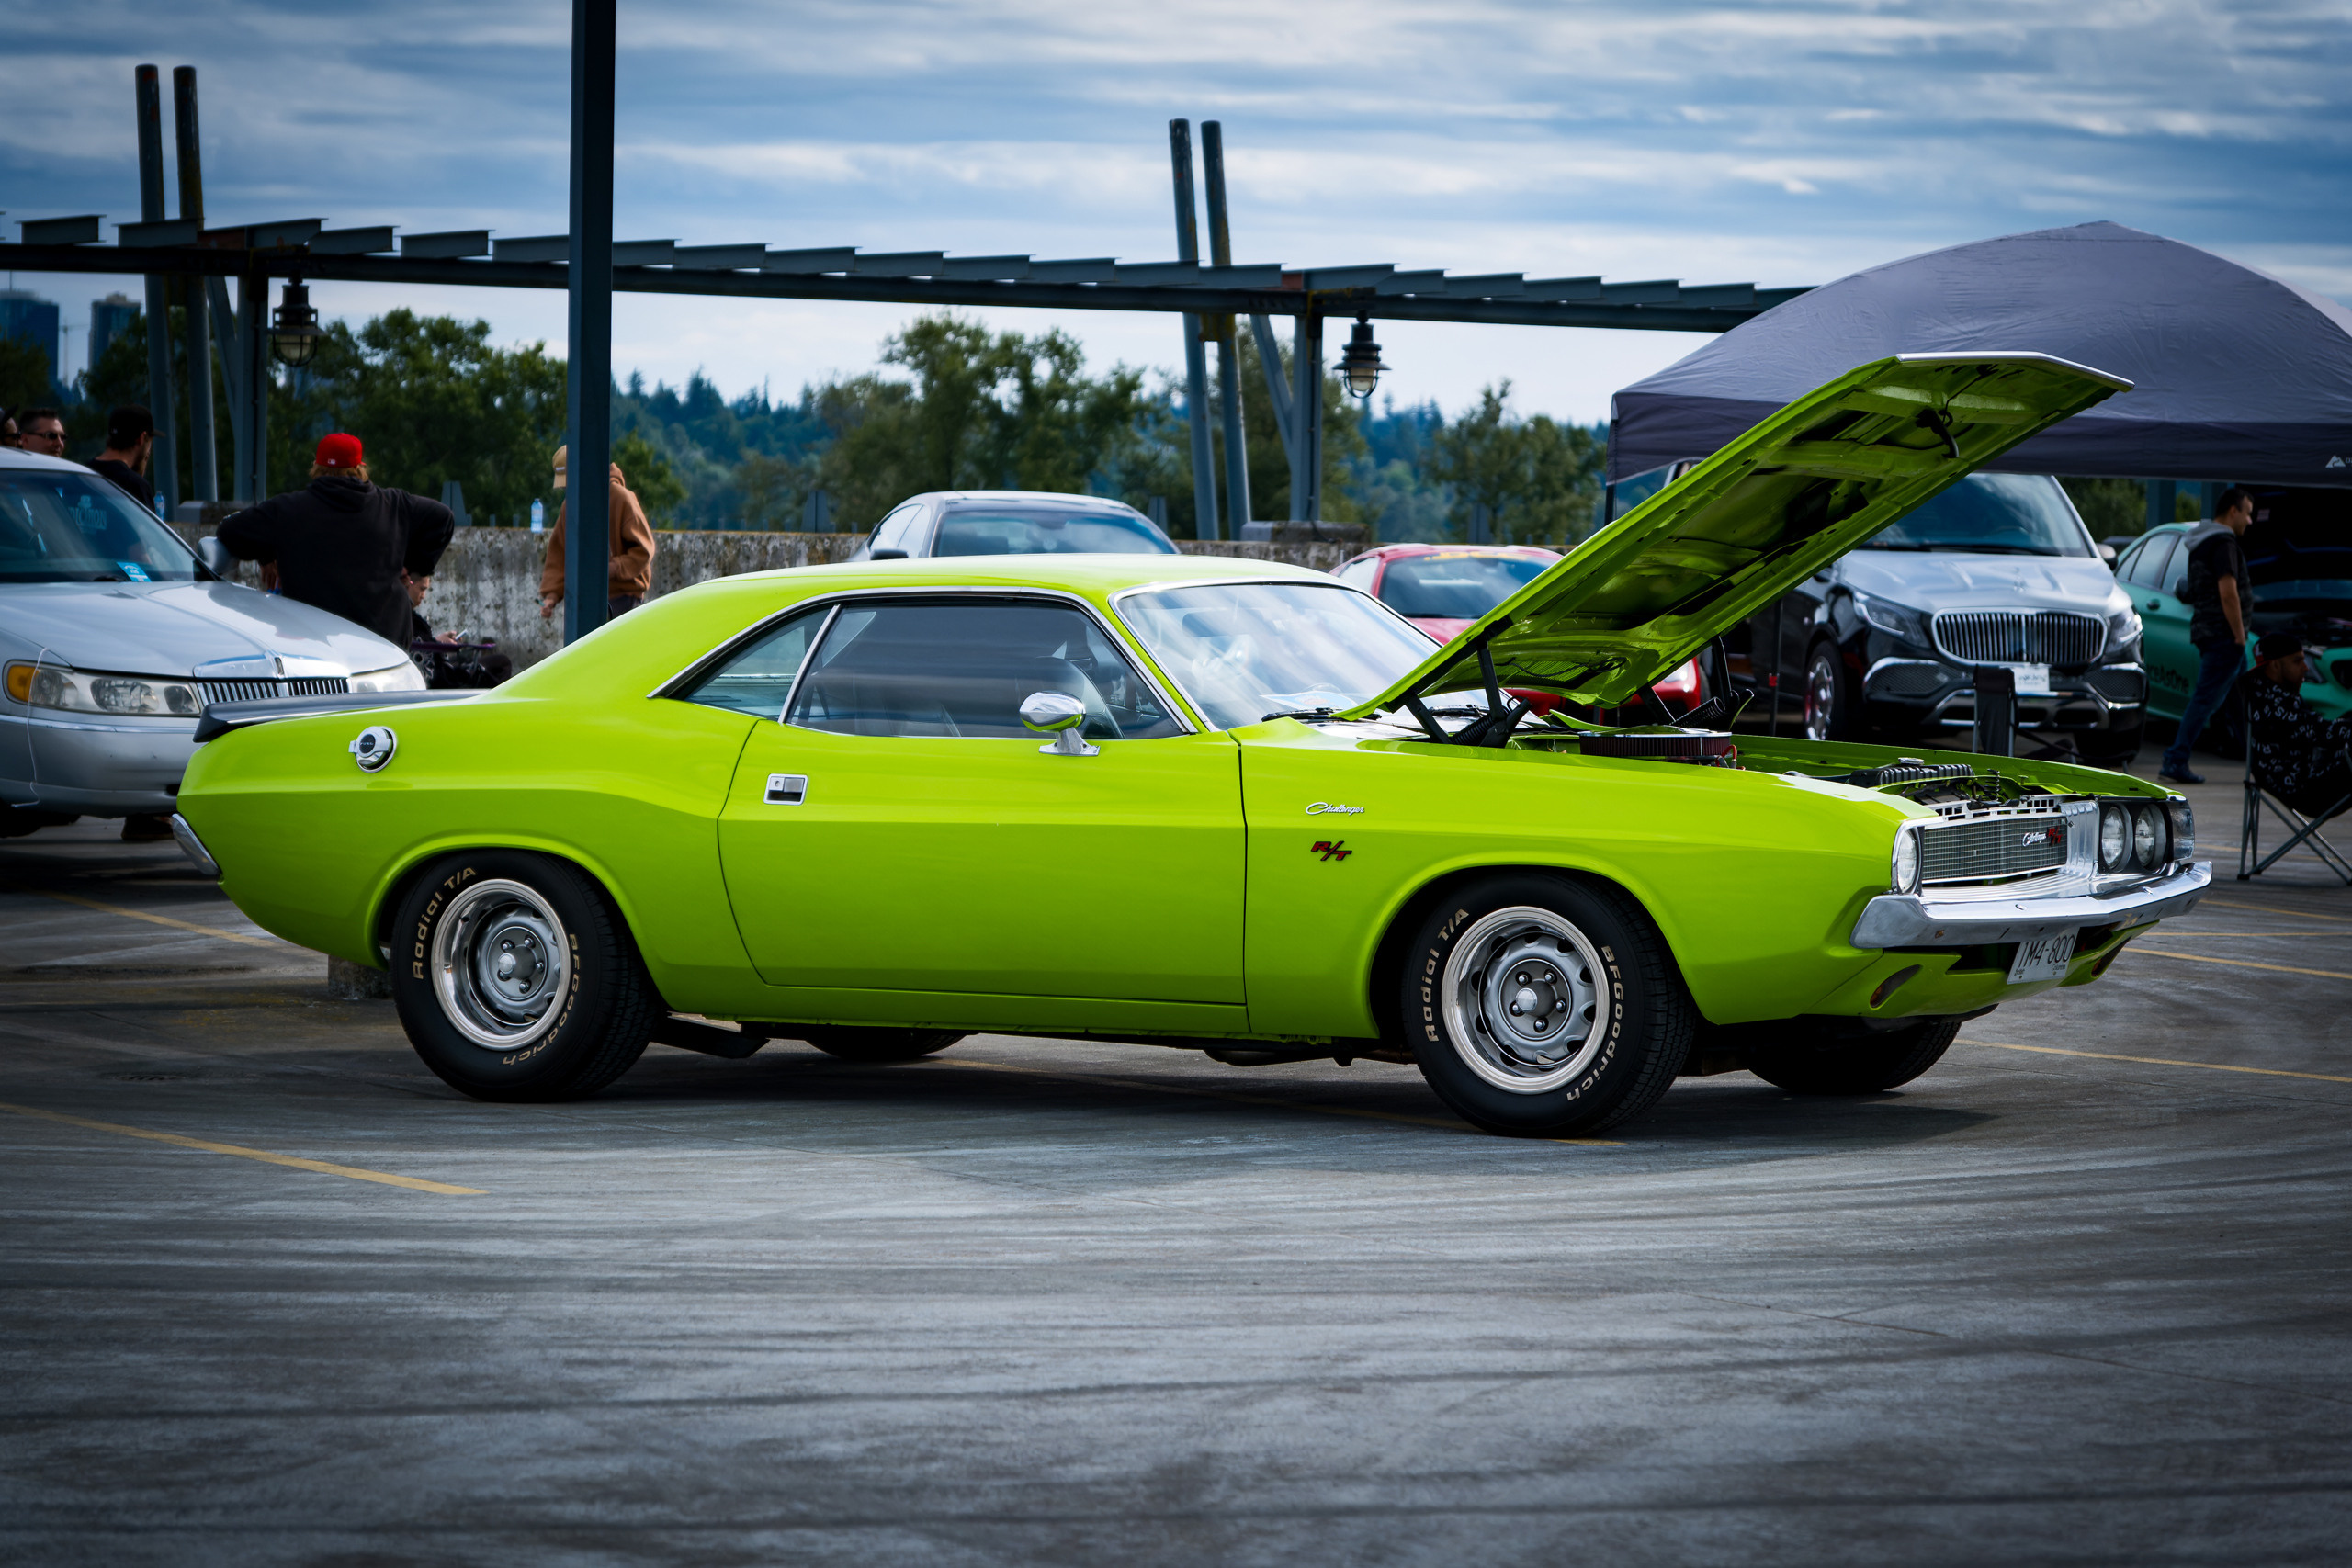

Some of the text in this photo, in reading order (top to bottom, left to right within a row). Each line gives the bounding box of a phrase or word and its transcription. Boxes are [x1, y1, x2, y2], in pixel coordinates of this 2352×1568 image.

[1306, 801, 1365, 817] Challenger
[1310, 840, 1353, 862] R/T
[412, 866, 477, 980] Radial T/A
[1421, 908, 1470, 1043] Radial T/A
[1566, 944, 1624, 1102] BFGoodrich
